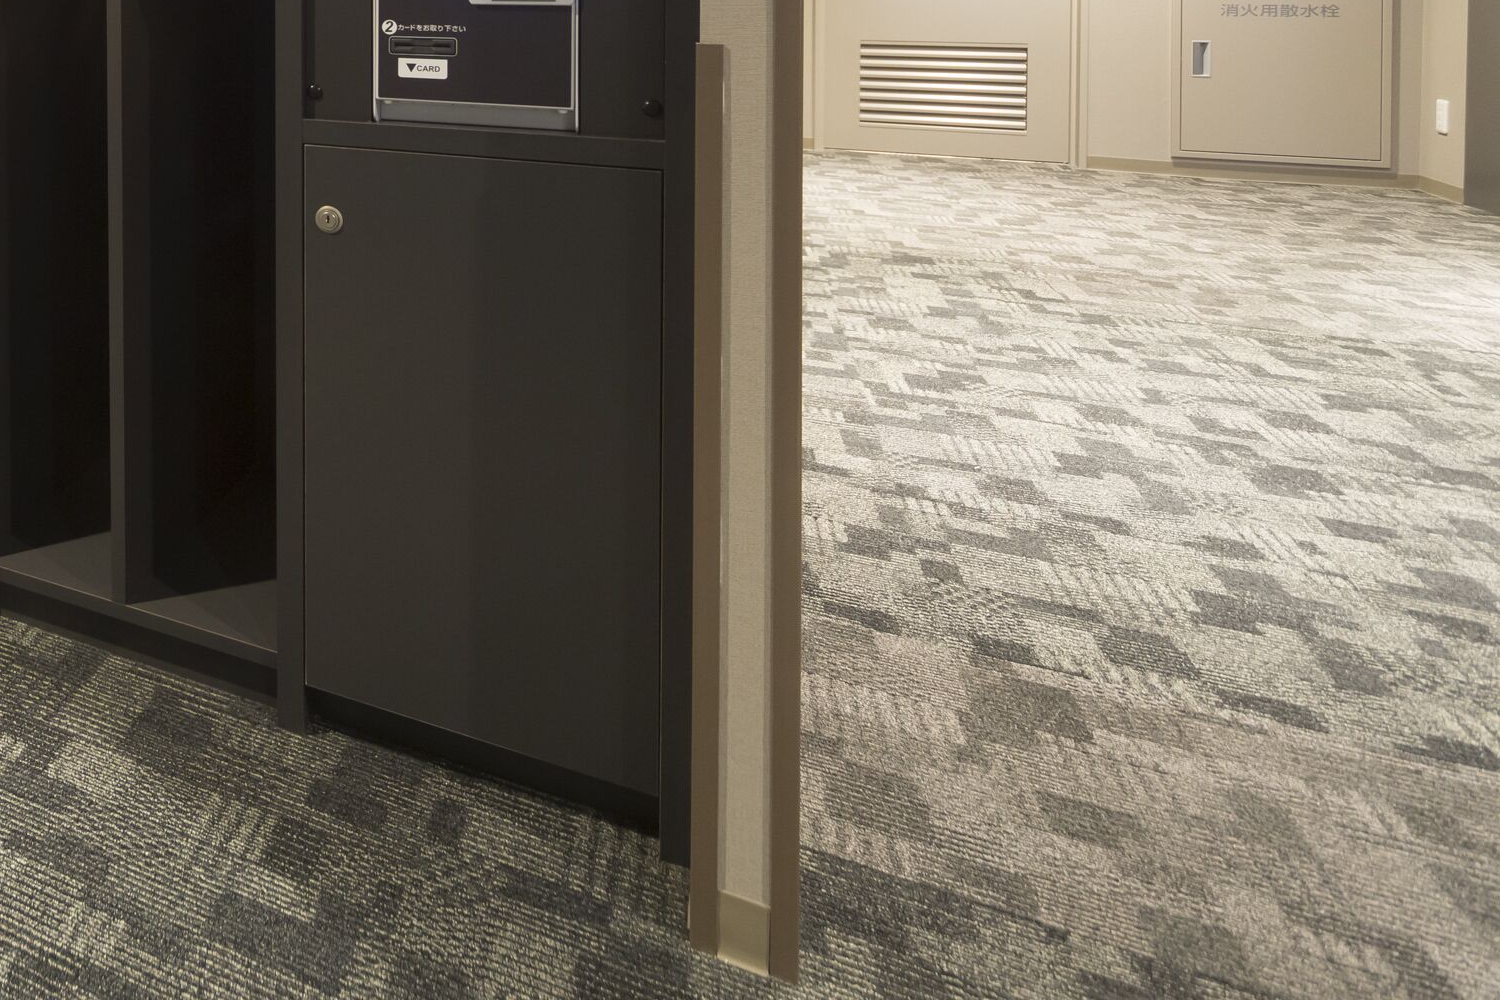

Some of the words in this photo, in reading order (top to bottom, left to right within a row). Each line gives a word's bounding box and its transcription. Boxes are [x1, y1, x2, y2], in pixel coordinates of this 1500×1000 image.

[1220, 4, 1340, 18] 消火用散水栓
[398, 24, 467, 33] カードをお取り下さい
[416, 65, 441, 73] CARD
